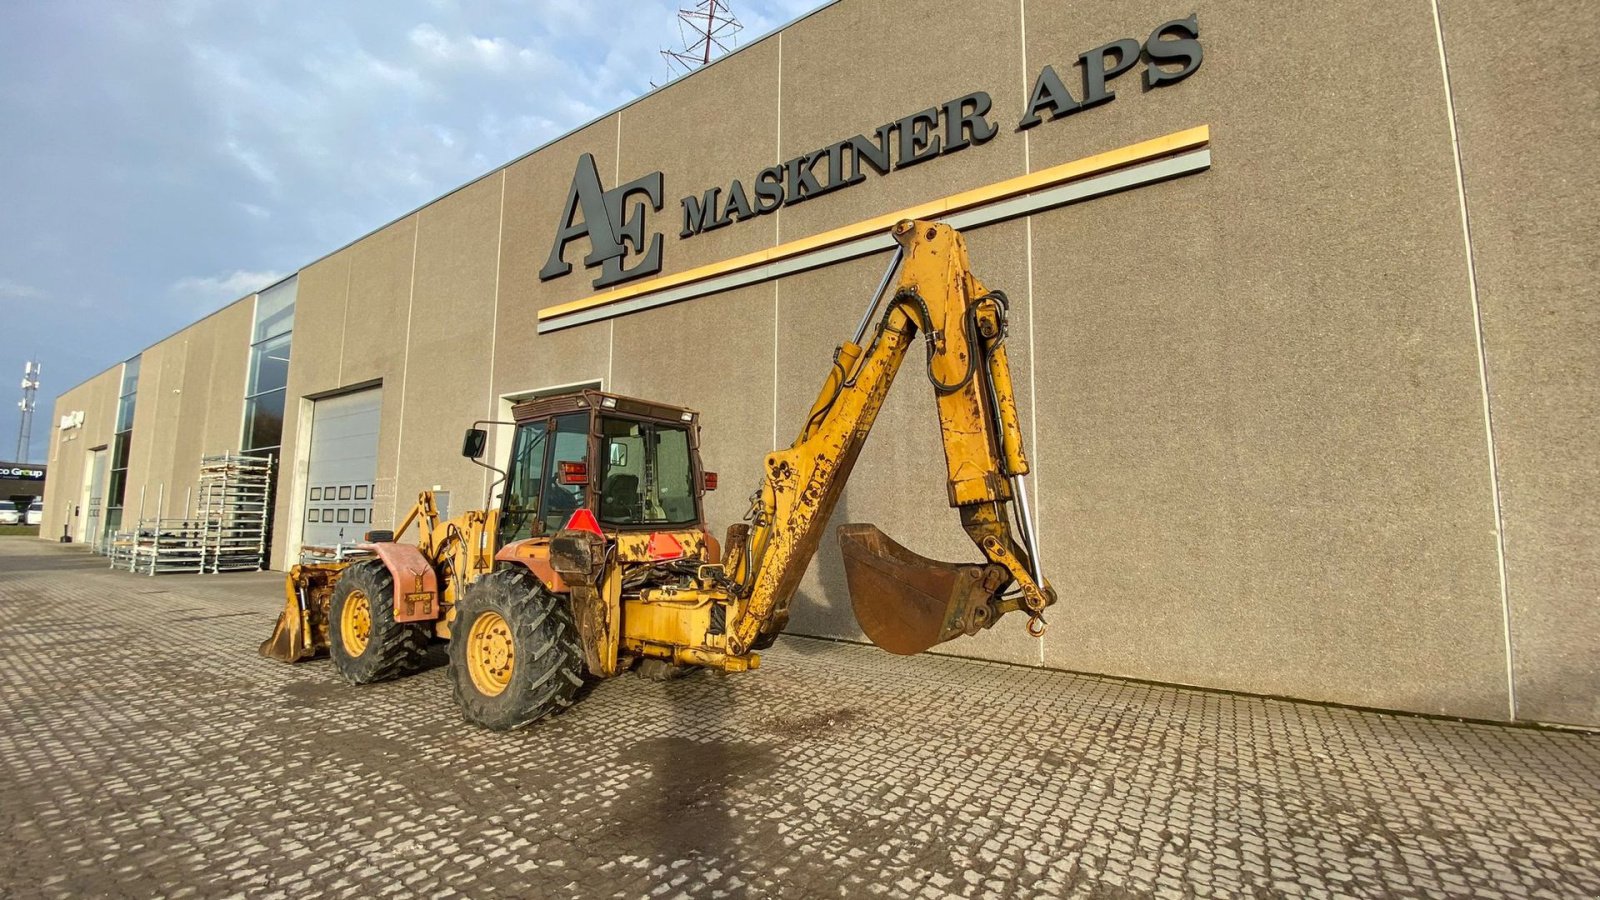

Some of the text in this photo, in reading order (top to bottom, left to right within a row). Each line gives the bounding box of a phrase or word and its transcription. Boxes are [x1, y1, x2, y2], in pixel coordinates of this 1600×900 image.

[540, 14, 1203, 288] AE MASKINER APS
[11, 467, 43, 478] Group
